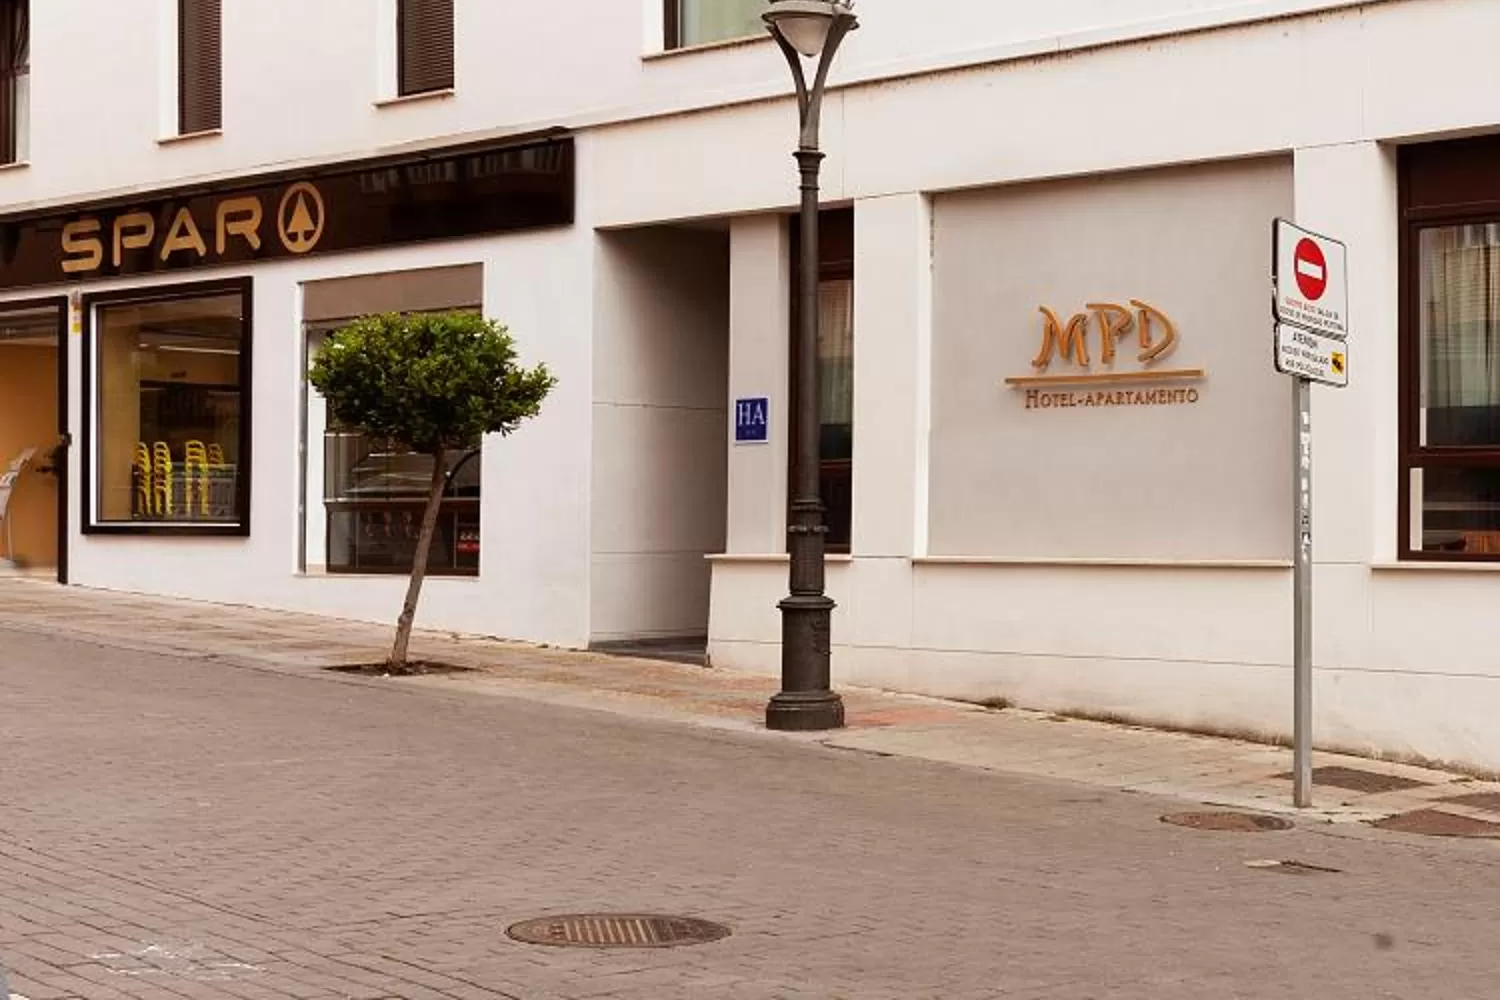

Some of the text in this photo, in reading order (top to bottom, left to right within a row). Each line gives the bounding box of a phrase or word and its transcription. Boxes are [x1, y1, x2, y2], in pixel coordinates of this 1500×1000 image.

[61, 195, 262, 273] SPAR
[1031, 299, 1177, 367] MPD
[738, 402, 765, 426] HA
